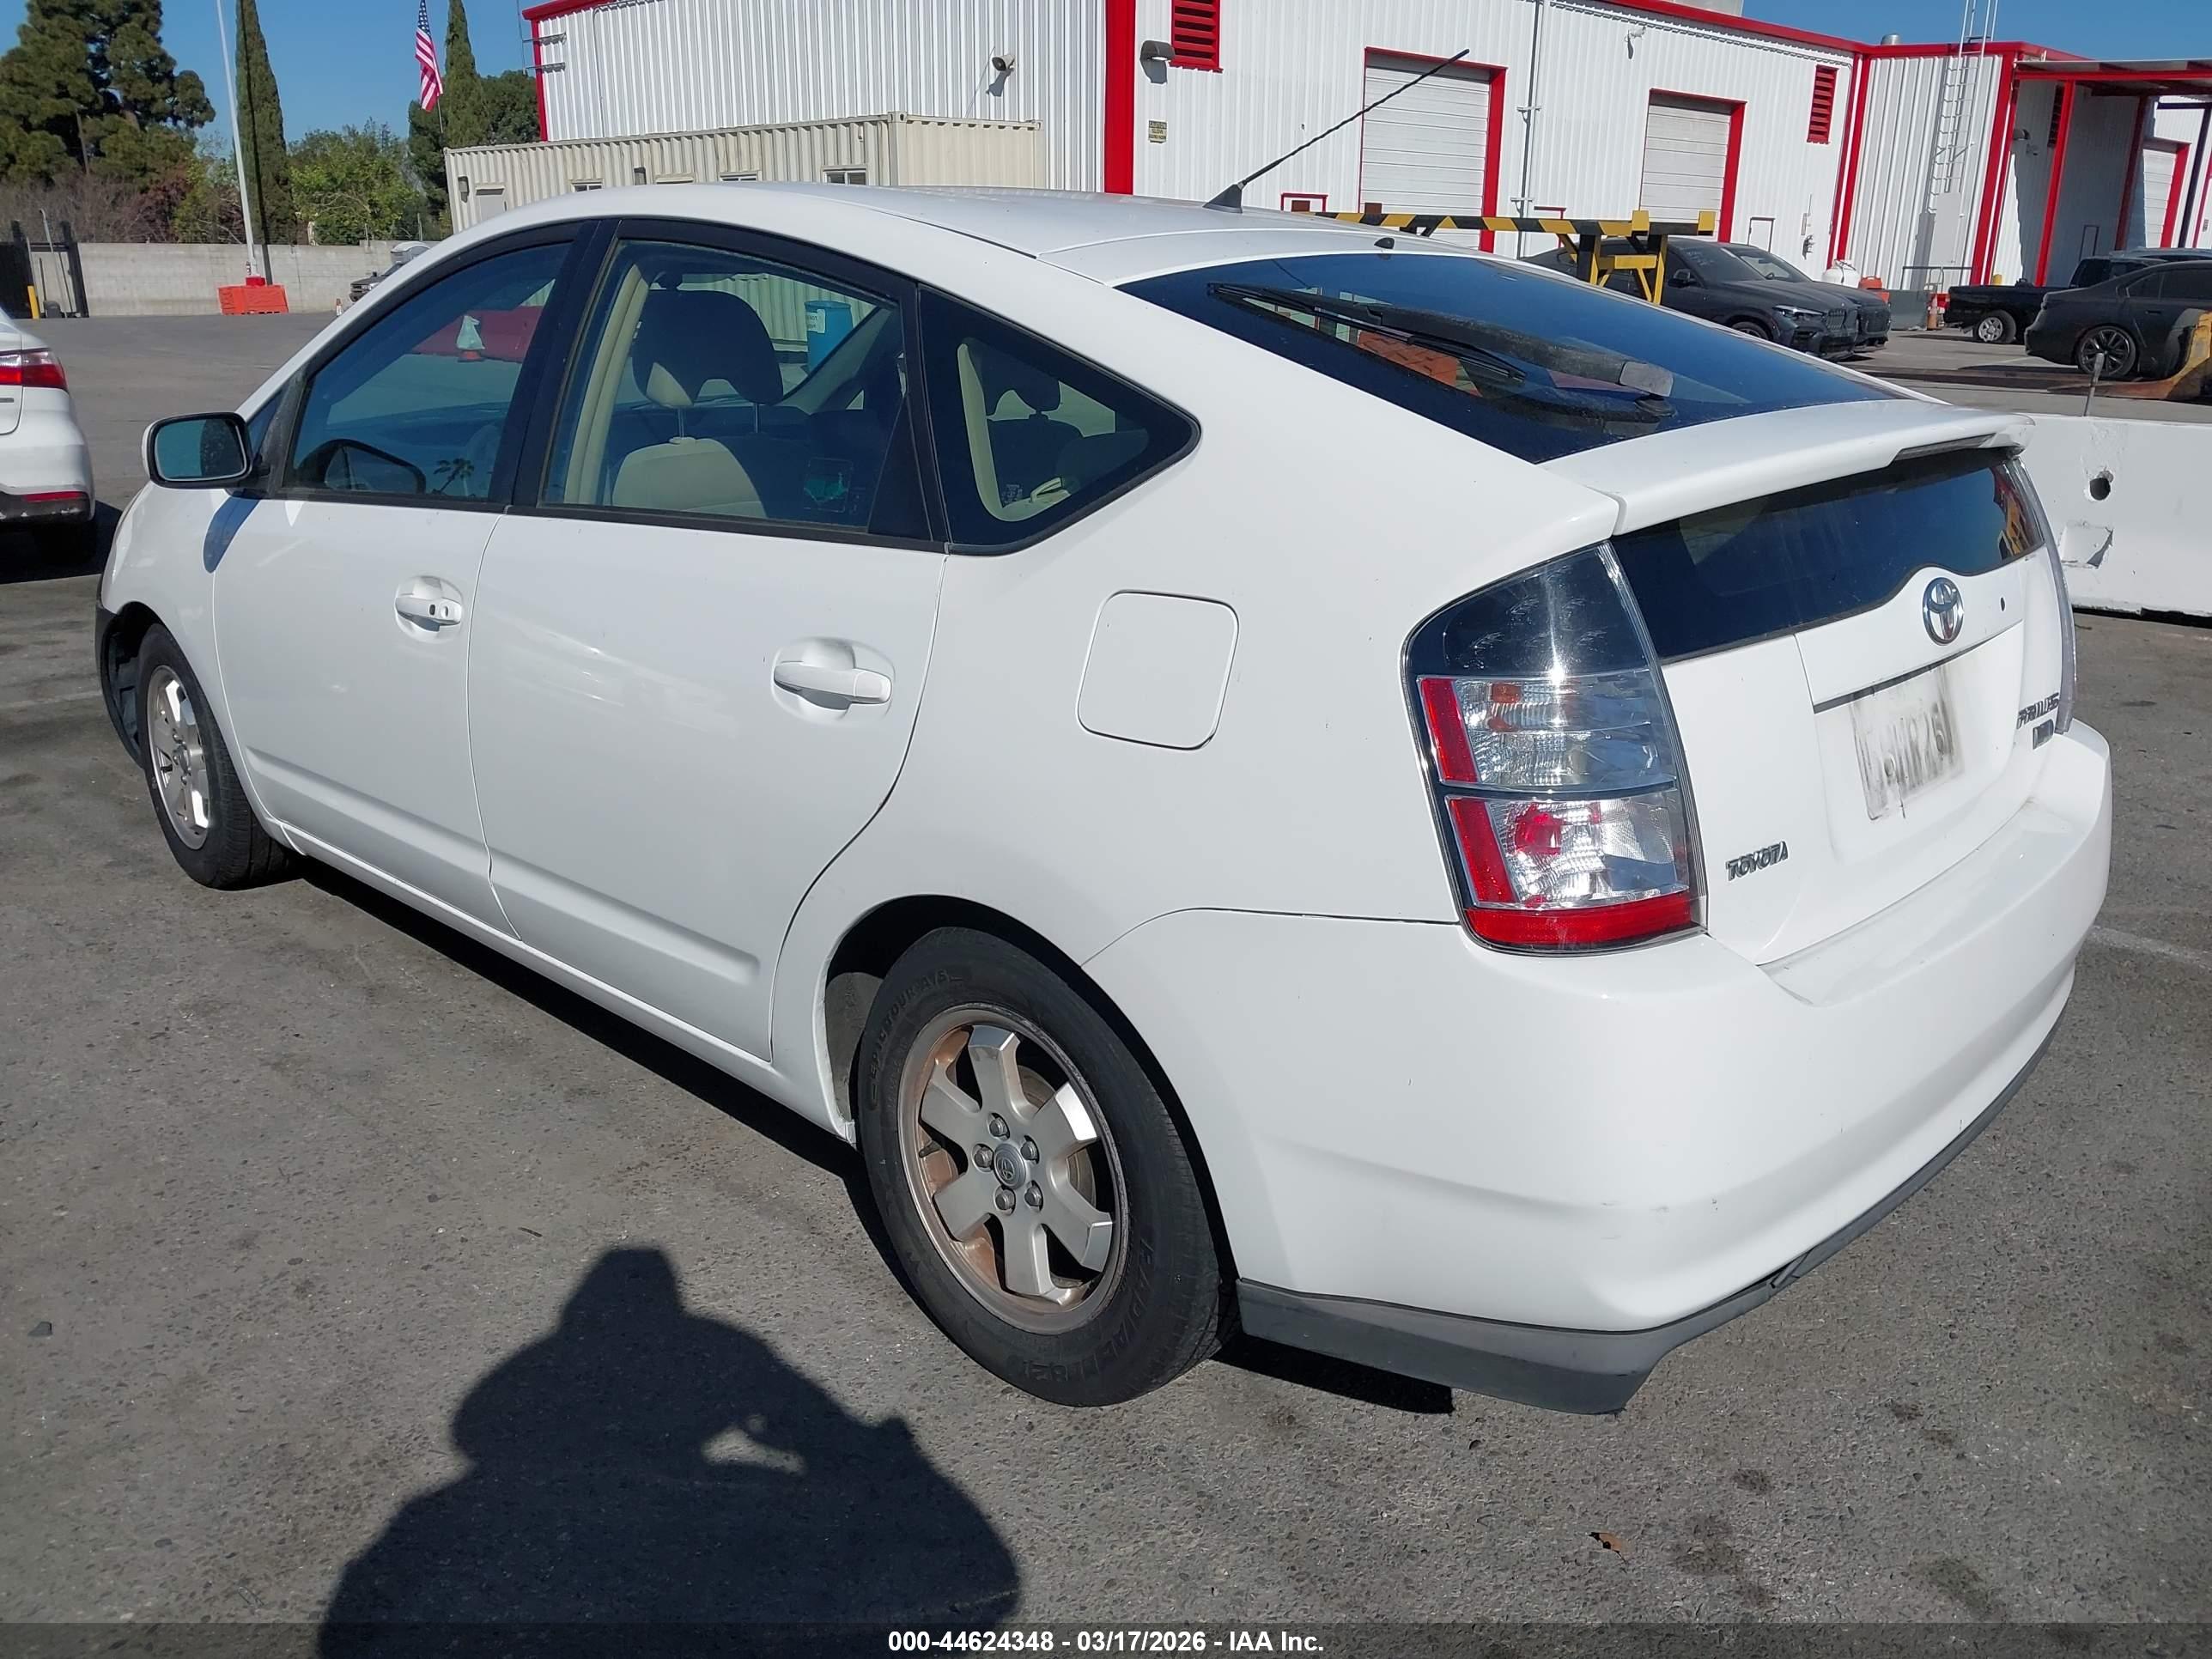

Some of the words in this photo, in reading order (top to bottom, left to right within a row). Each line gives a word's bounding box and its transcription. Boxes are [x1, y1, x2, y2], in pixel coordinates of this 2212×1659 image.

[2015, 692, 2059, 730] PRIUS
[1725, 841, 1789, 881] TOYOTA
[867, 1025, 889, 1082] EPIC
[883, 982, 916, 1031] TOUR
